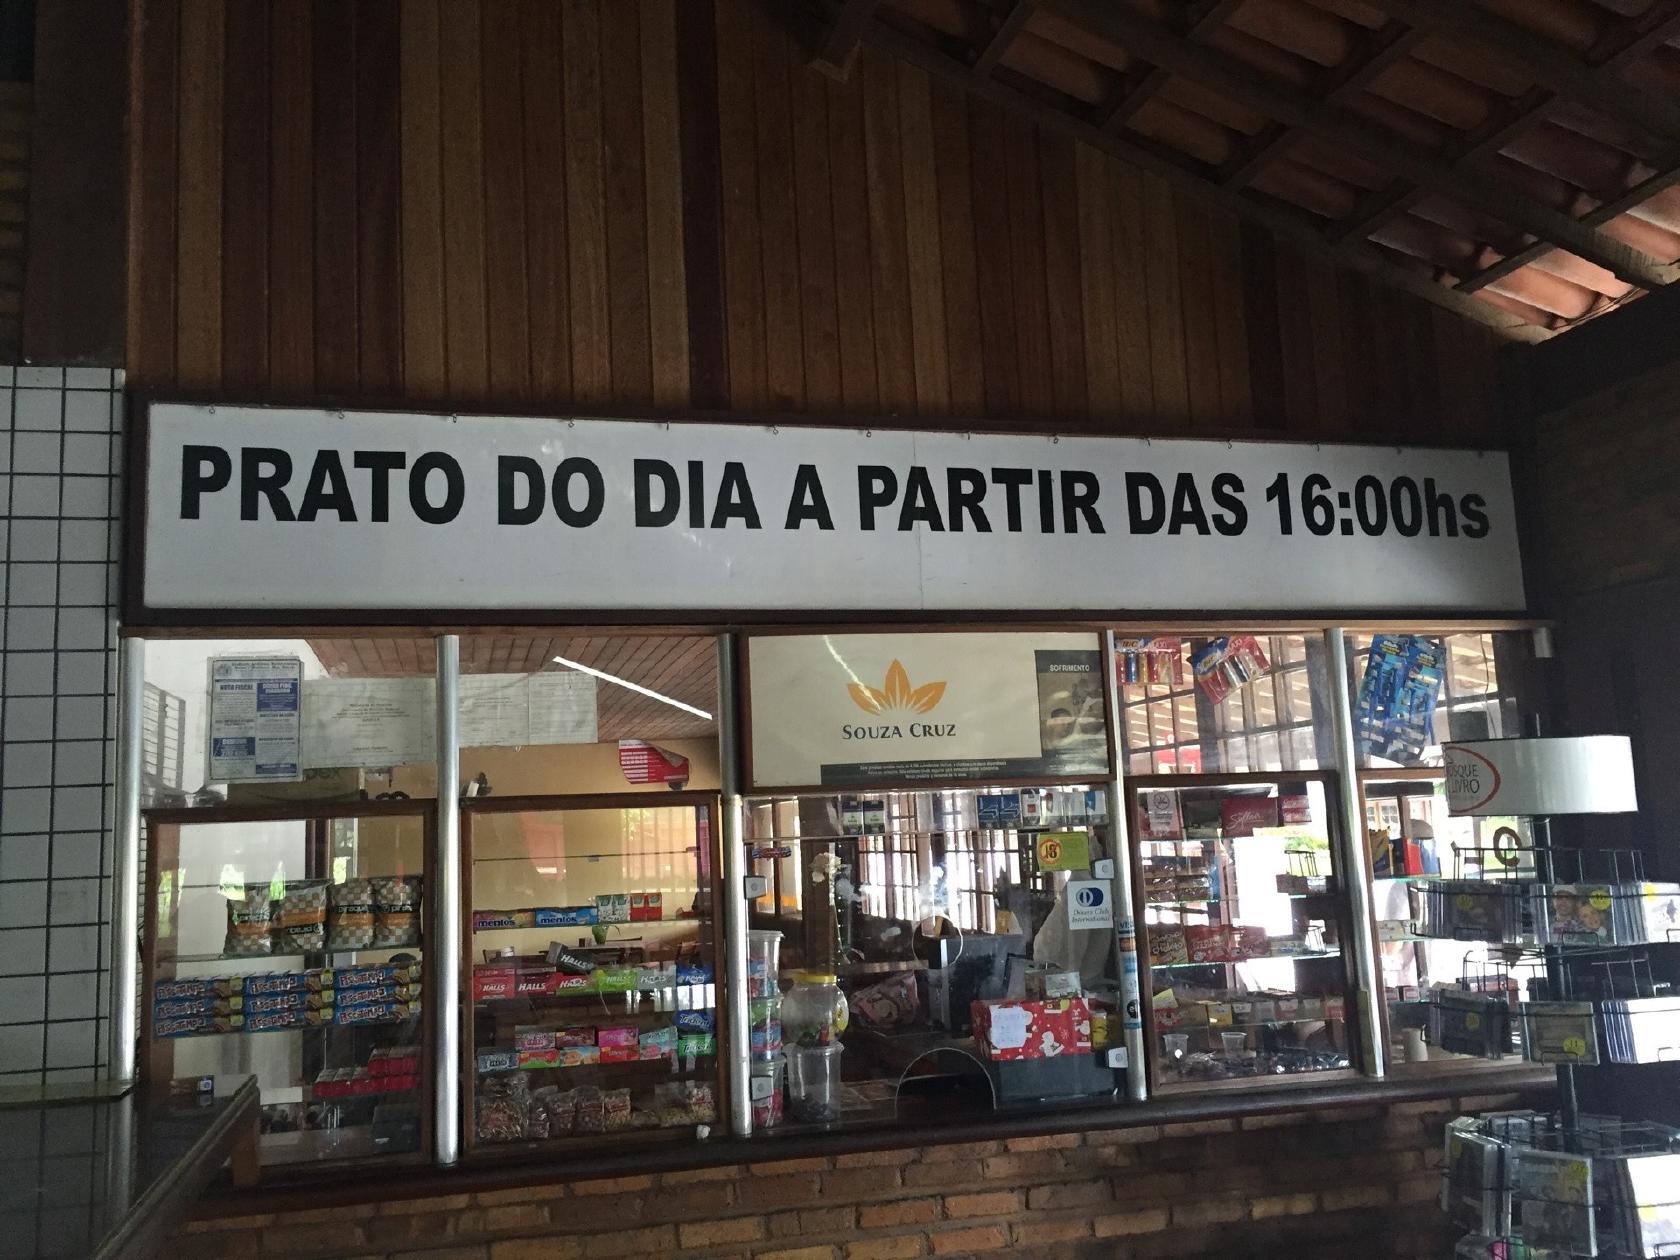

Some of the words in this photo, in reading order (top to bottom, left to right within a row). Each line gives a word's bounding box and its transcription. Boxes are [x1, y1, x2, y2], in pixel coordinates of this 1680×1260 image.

[179, 444, 465, 525] PRATO
[497, 455, 605, 529] DO
[633, 458, 763, 530] DIA
[784, 464, 835, 531] A
[857, 465, 1107, 534] PARTIR
[1125, 471, 1248, 537] DAS
[1265, 472, 1491, 540] 16:00hs
[1049, 664, 1090, 672] SOFRIMENTO
[842, 724, 903, 740] SOUZA
[909, 722, 957, 738] CRUZ
[478, 918, 516, 927] mentos
[540, 916, 578, 925] mentos
[560, 954, 587, 969] HALLS
[482, 984, 506, 992] HALLS
[518, 982, 546, 991] HALLS
